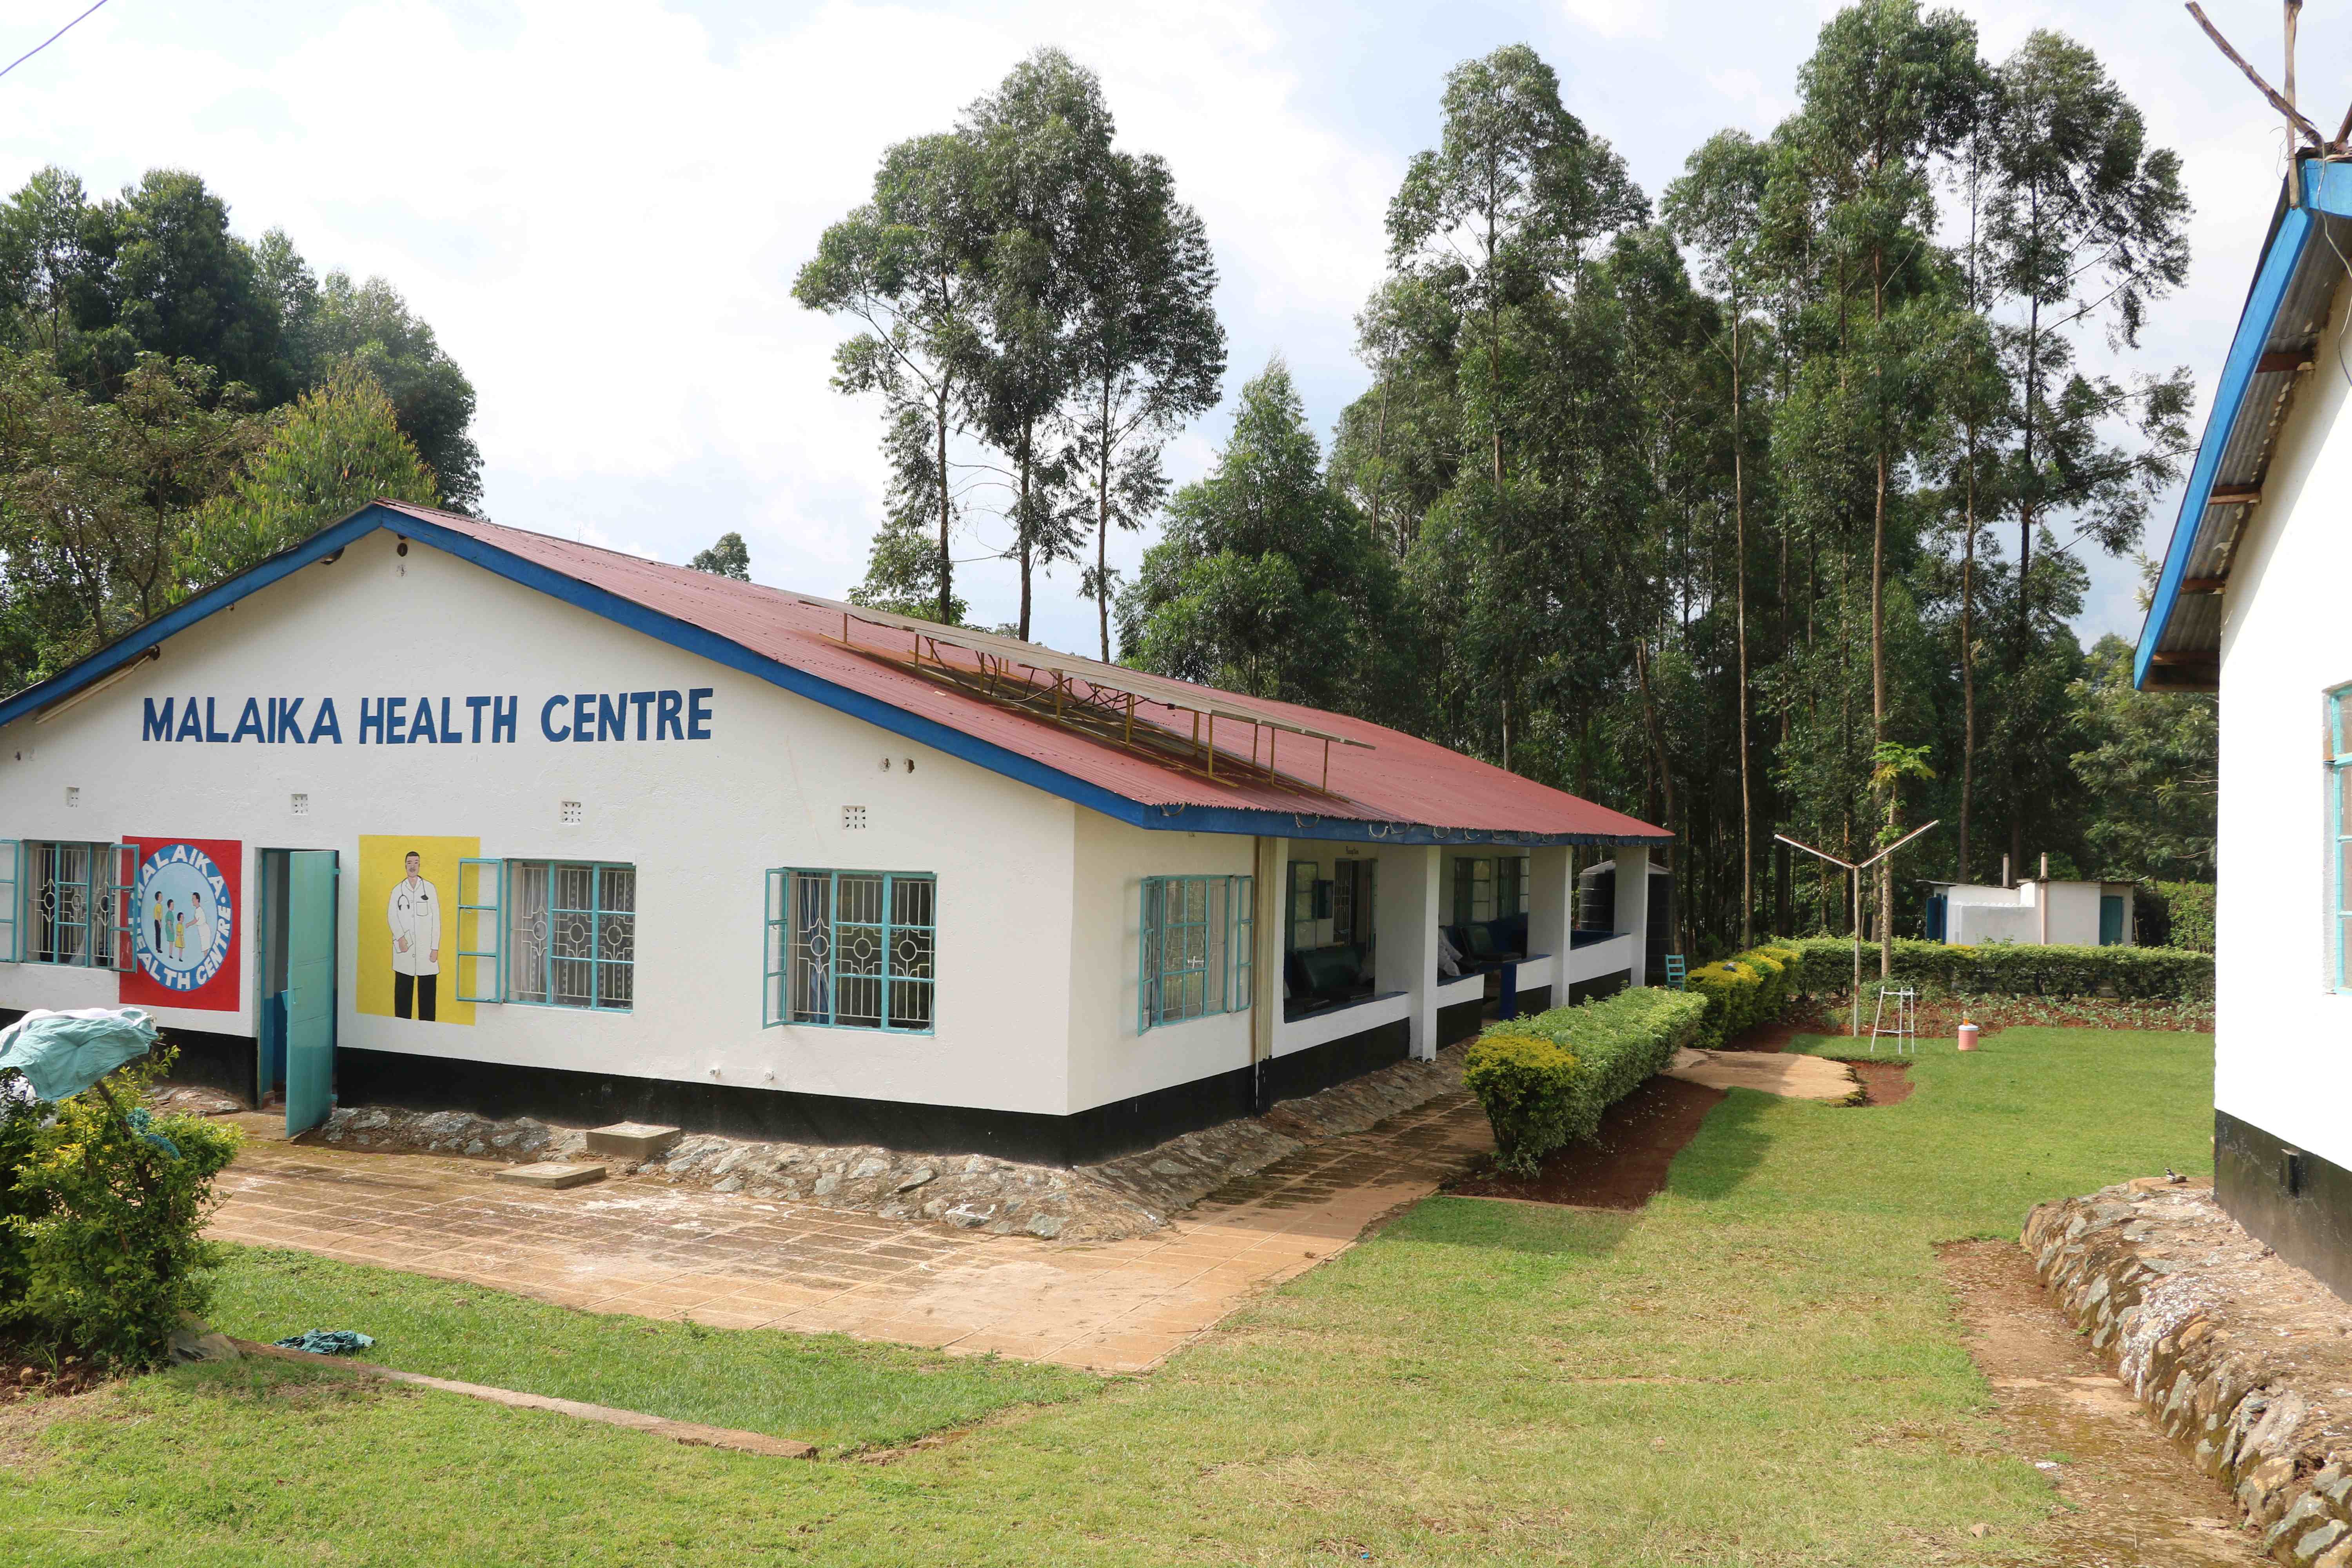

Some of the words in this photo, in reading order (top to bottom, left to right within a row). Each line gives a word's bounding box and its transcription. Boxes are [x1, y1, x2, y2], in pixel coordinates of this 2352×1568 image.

[142, 697, 342, 744] MALAIKA
[359, 695, 517, 744] HEALTH
[541, 688, 713, 742] CENTRE
